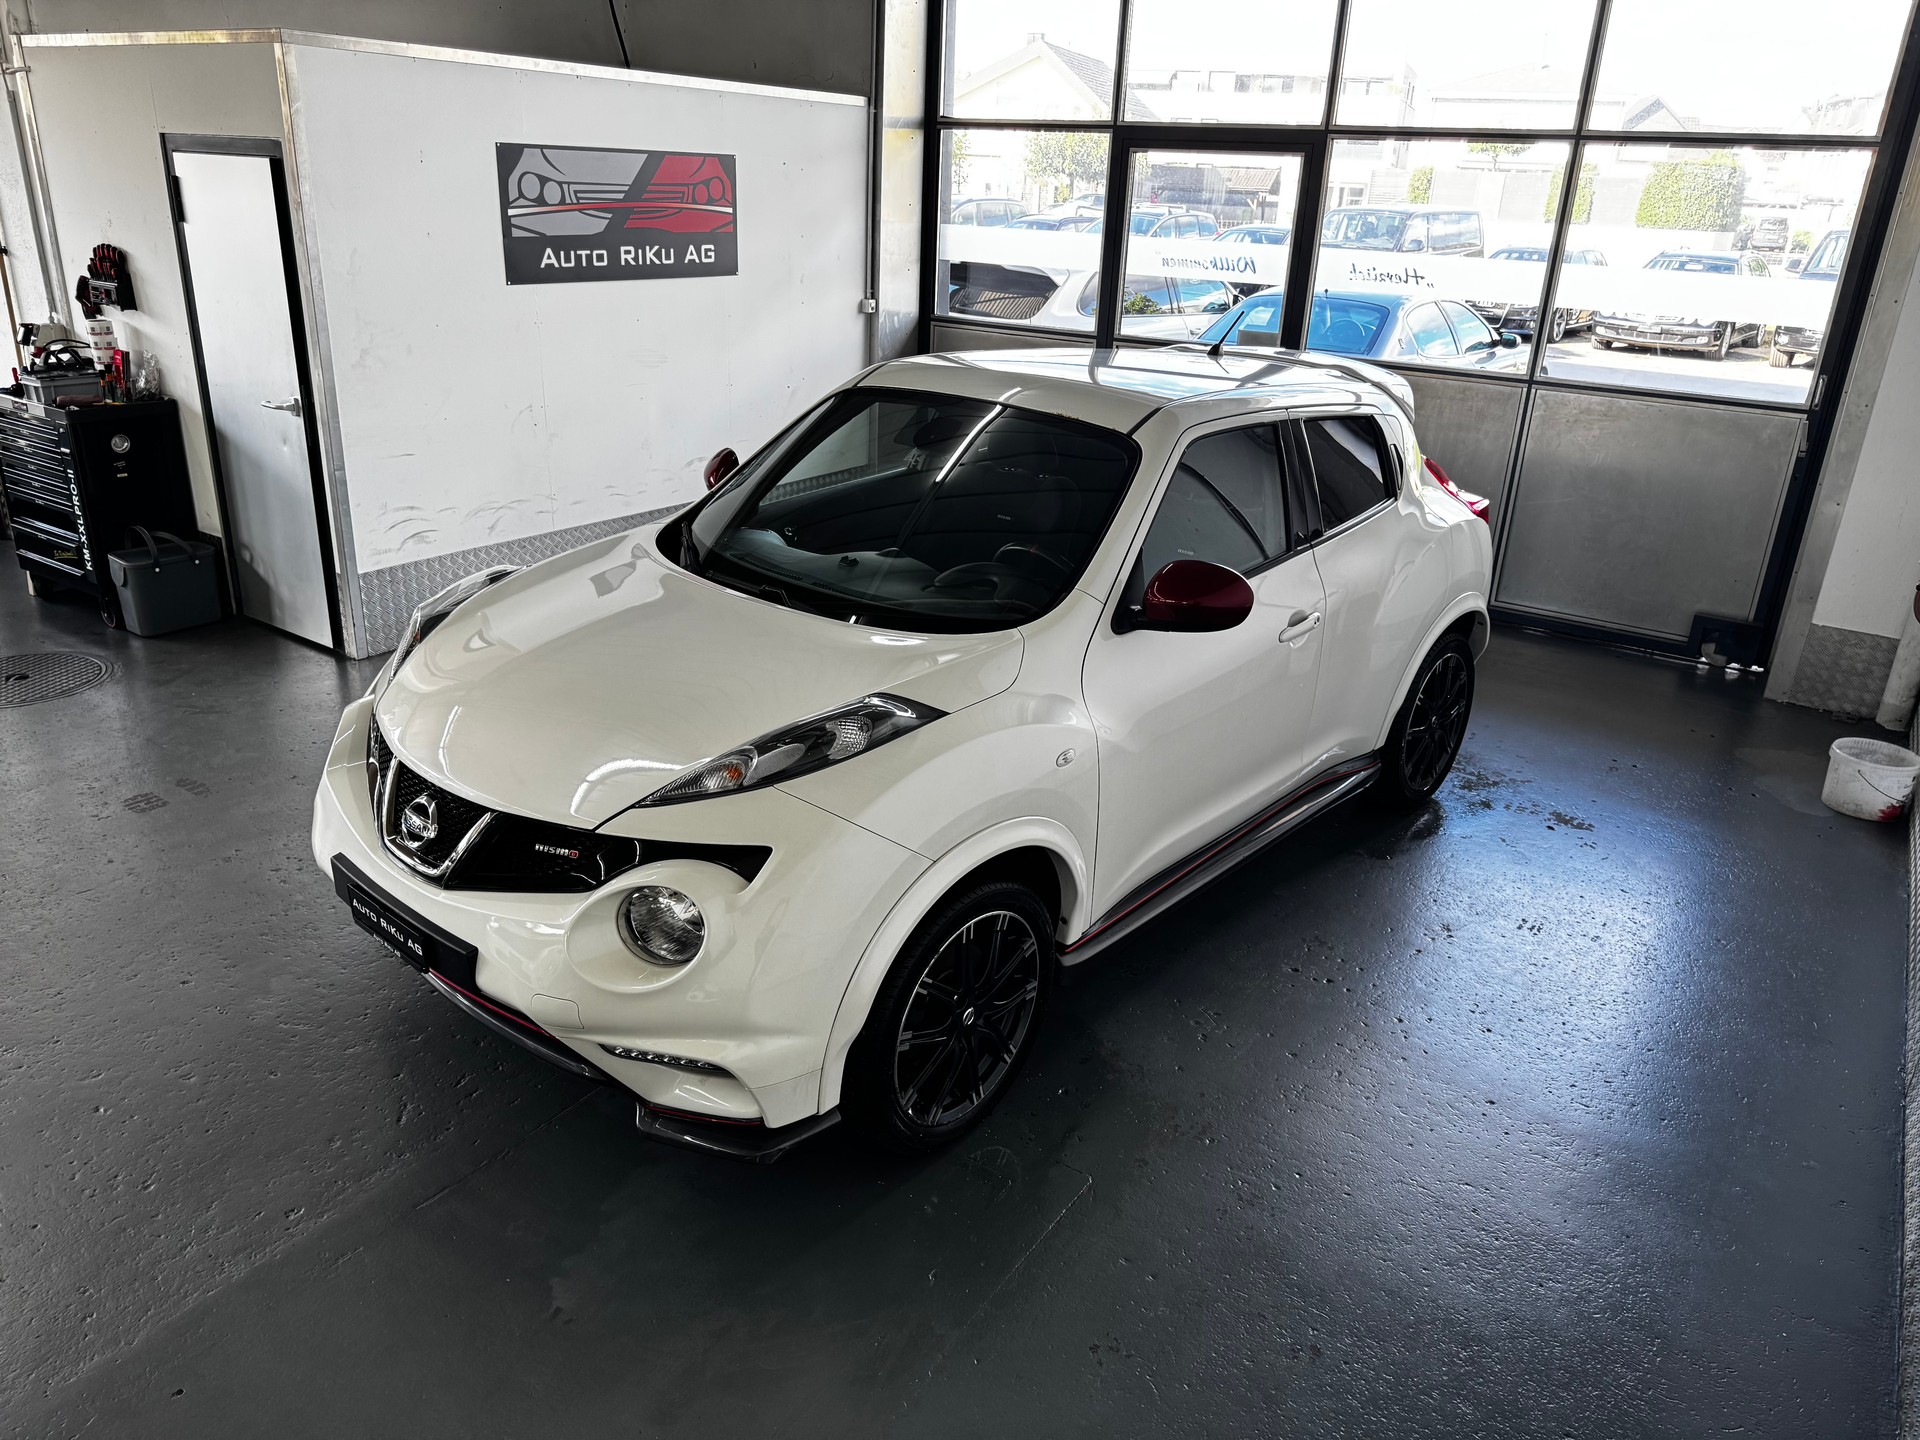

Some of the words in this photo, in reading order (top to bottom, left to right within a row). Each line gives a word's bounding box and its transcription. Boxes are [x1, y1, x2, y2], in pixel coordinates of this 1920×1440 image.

[540, 247, 608, 268] AUTO
[684, 244, 715, 263] AG
[353, 898, 377, 922] AUTO
[407, 938, 423, 956] AG
